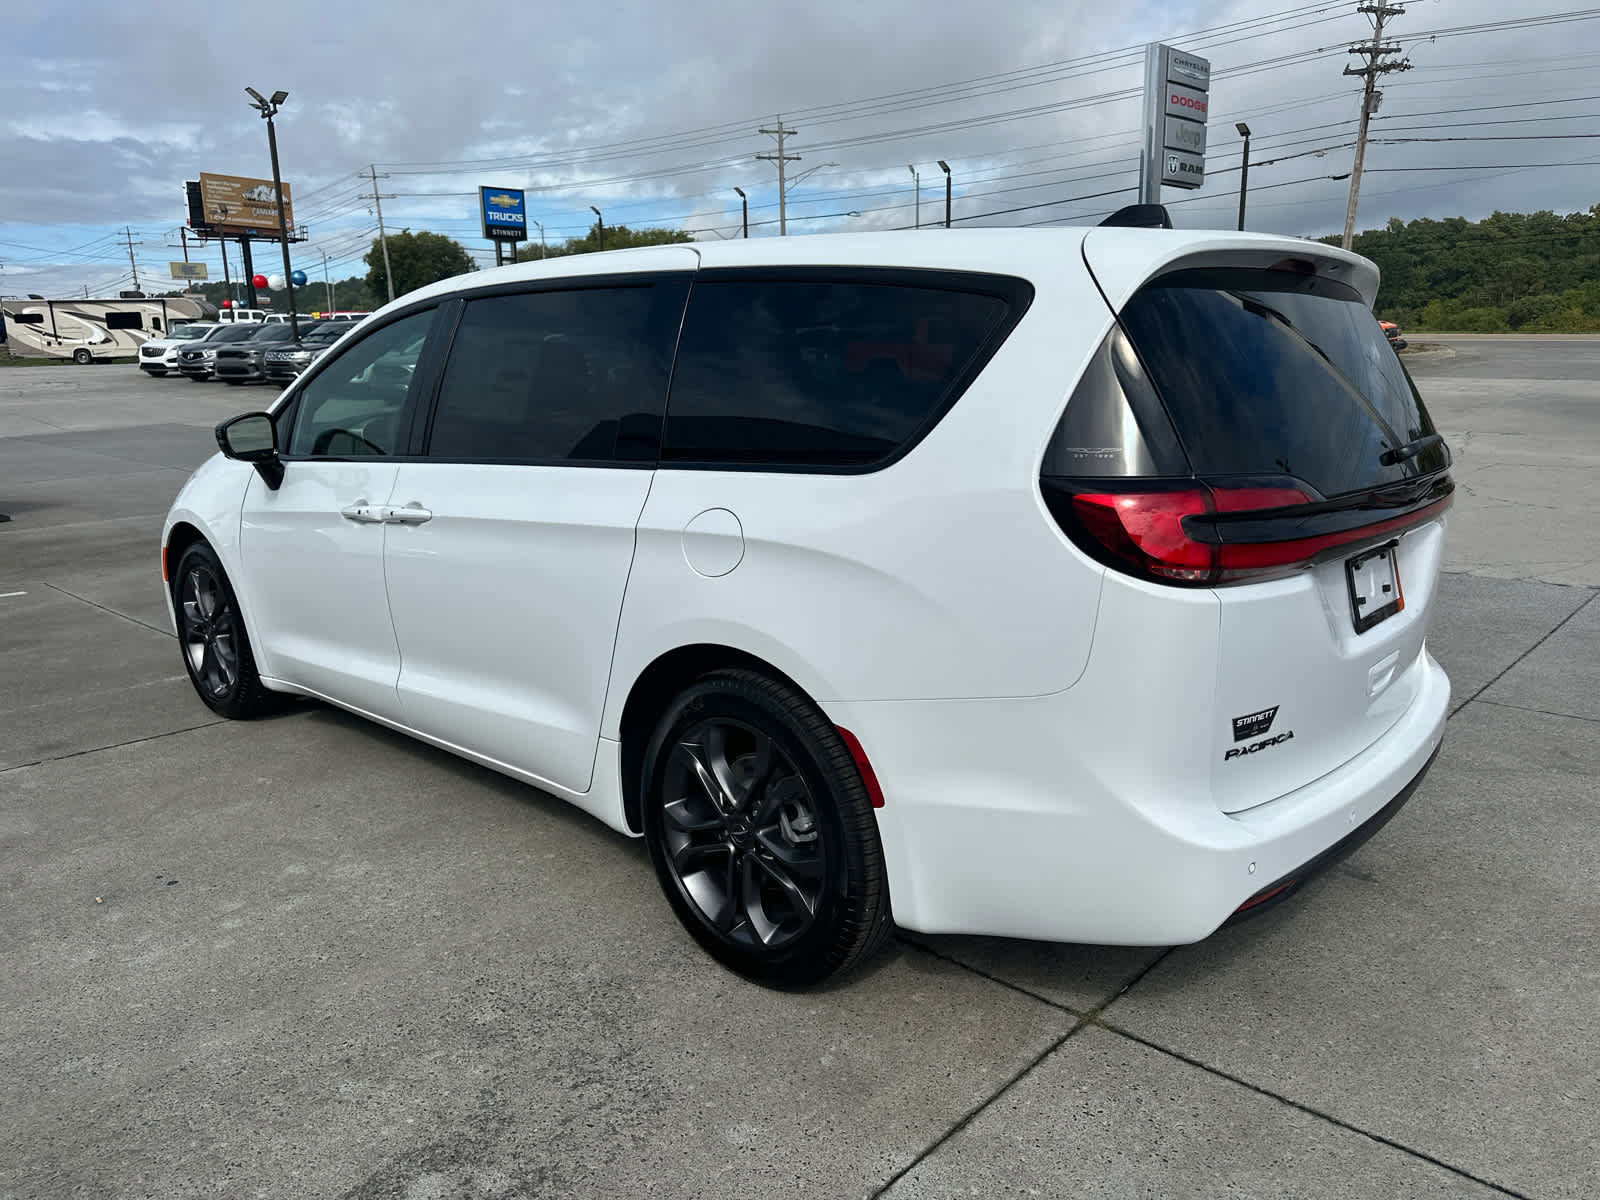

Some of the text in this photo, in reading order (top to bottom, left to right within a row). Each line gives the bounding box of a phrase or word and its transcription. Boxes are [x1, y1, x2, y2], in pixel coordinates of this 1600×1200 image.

[1170, 94, 1207, 112] DODGE
[1180, 162, 1203, 175] RAM
[487, 211, 524, 222] TRUCKS
[492, 229, 522, 237] STINNETT
[1237, 710, 1274, 727] STINNETT
[1224, 730, 1294, 761] PACIFICA
